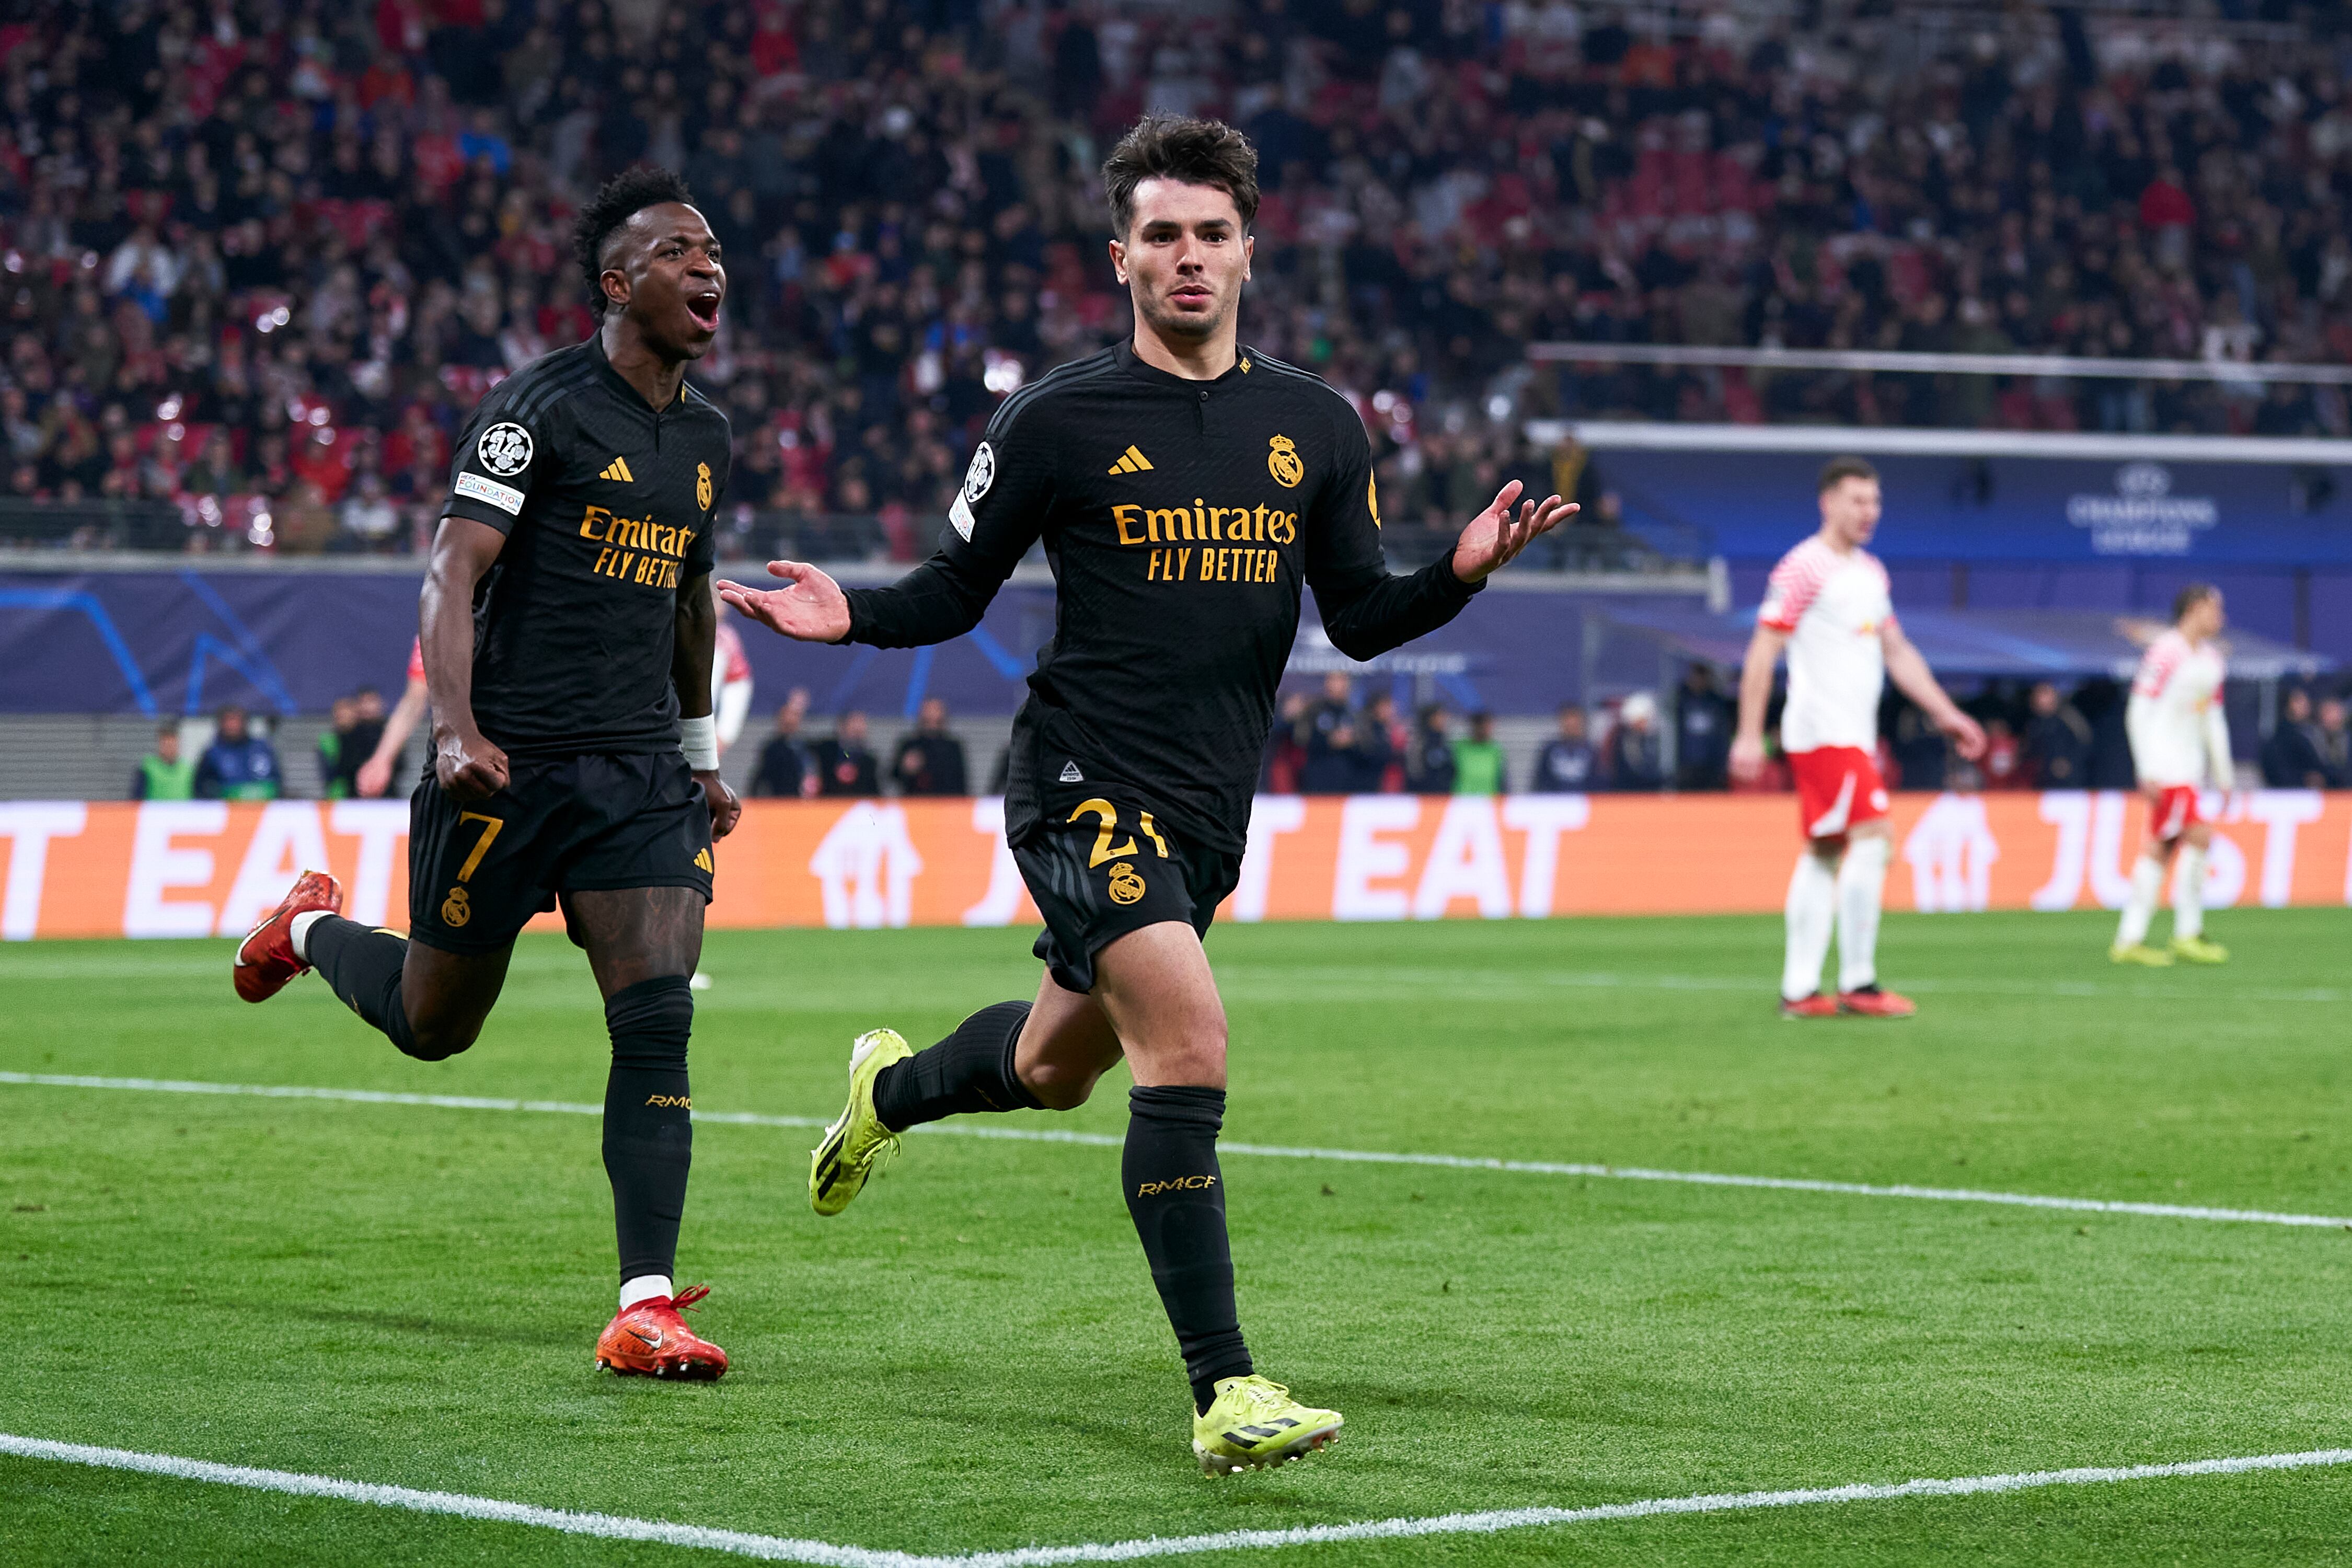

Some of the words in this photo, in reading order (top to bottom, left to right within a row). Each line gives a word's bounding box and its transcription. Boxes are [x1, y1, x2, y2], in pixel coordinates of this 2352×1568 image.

[490, 436, 517, 462] 14
[458, 479, 521, 508] FOUNDATION
[580, 505, 698, 558] Emirat
[1111, 498, 1298, 545] Emirates
[593, 547, 635, 580] FLY
[1147, 548, 1192, 581] FLY
[1200, 548, 1278, 583] BETTER
[456, 811, 504, 883] 7
[1330, 794, 1592, 921] EAT
[124, 800, 410, 939] EAT
[1138, 1175, 1216, 1198] RMCF
